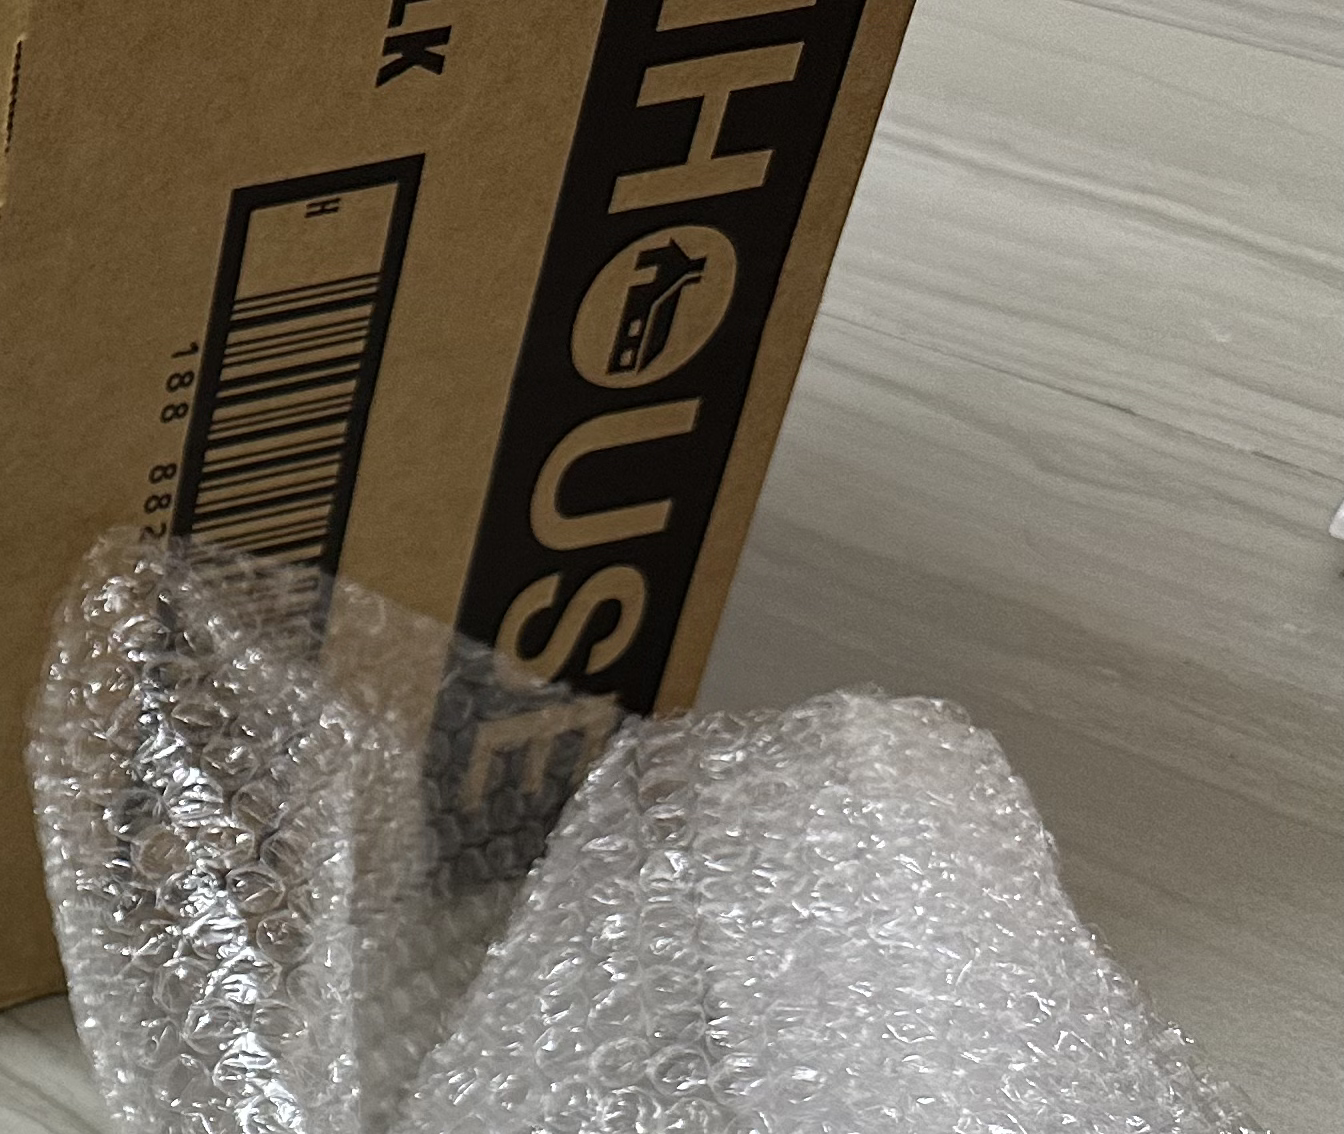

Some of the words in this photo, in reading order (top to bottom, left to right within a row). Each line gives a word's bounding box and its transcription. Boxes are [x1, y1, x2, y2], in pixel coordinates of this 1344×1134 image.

[304, 197, 341, 219] H
[159, 341, 199, 424] 188
[139, 463, 178, 543] 882
